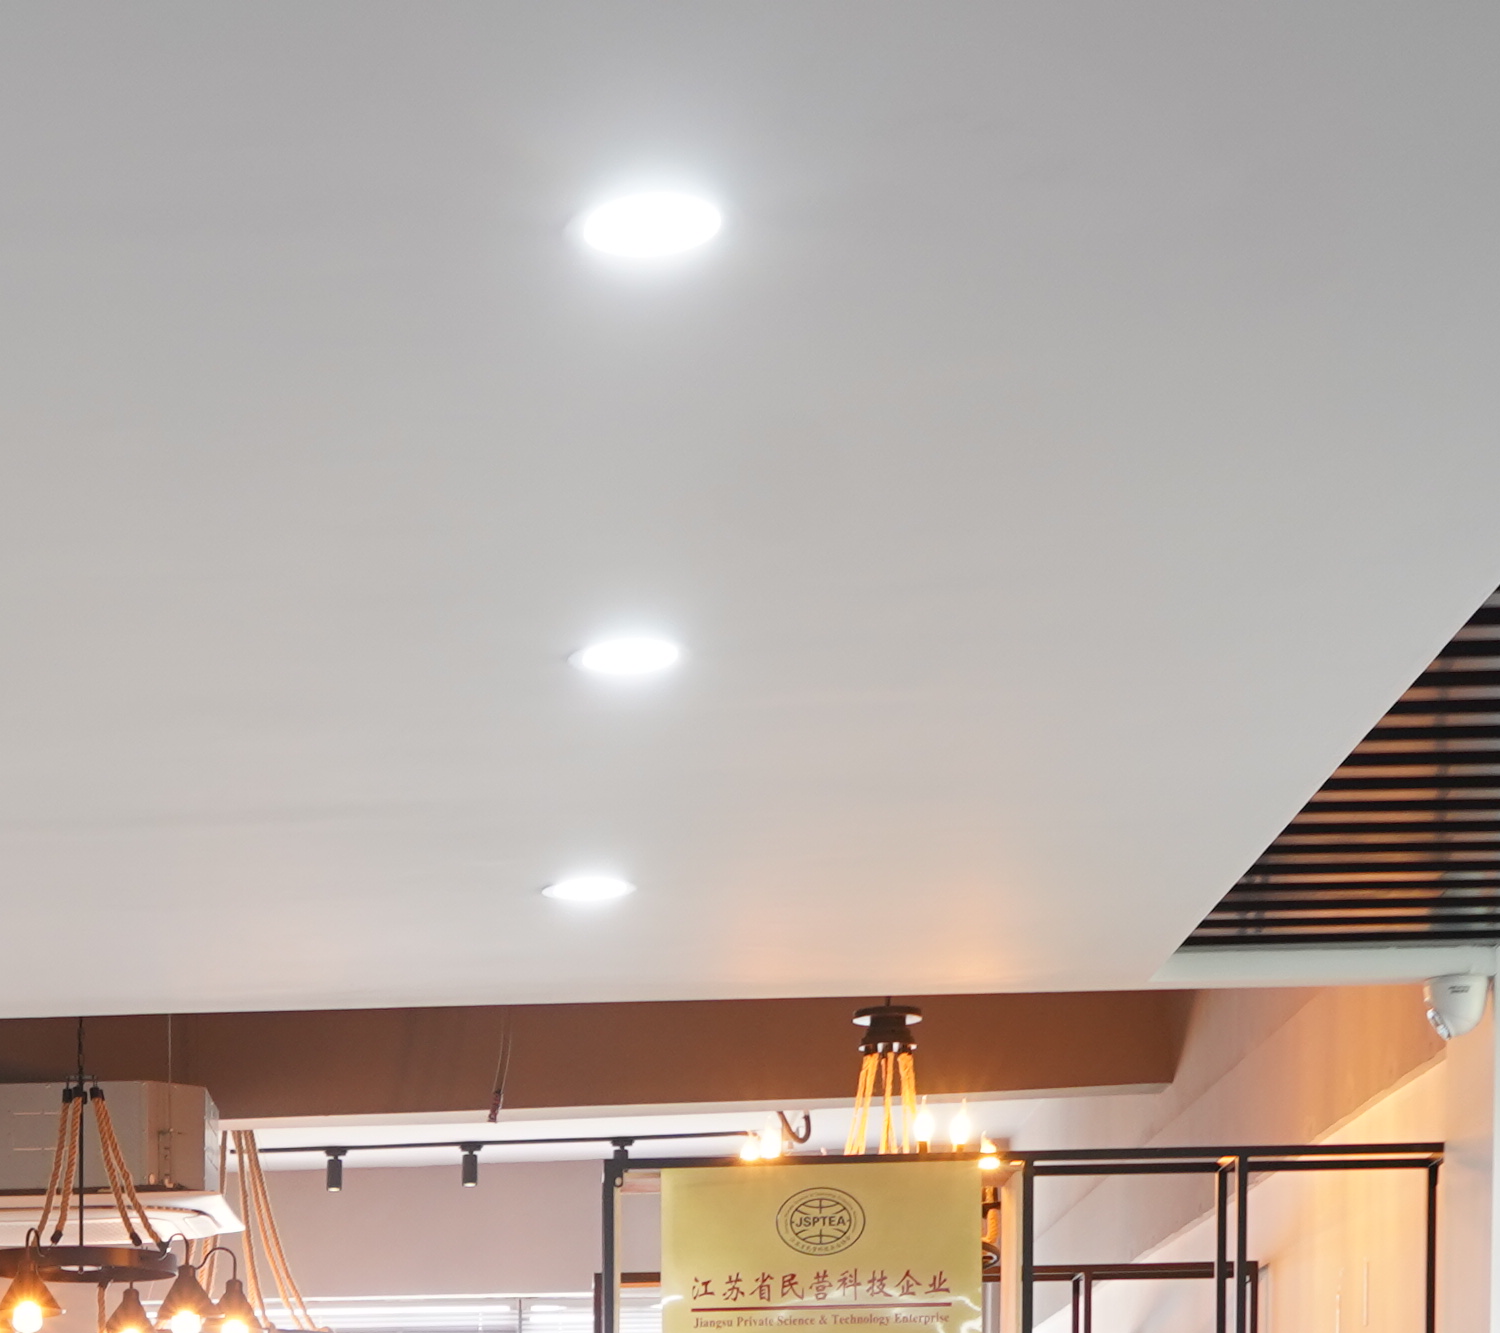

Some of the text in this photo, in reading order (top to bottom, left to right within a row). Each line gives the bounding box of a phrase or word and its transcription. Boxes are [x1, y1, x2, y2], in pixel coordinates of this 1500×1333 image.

[795, 1215, 847, 1227] JSPTEA
[692, 1268, 951, 1301] 江苏省民营科技企业
[693, 1312, 950, 1329] Jiangsu Private Science & Technology Enterprise
